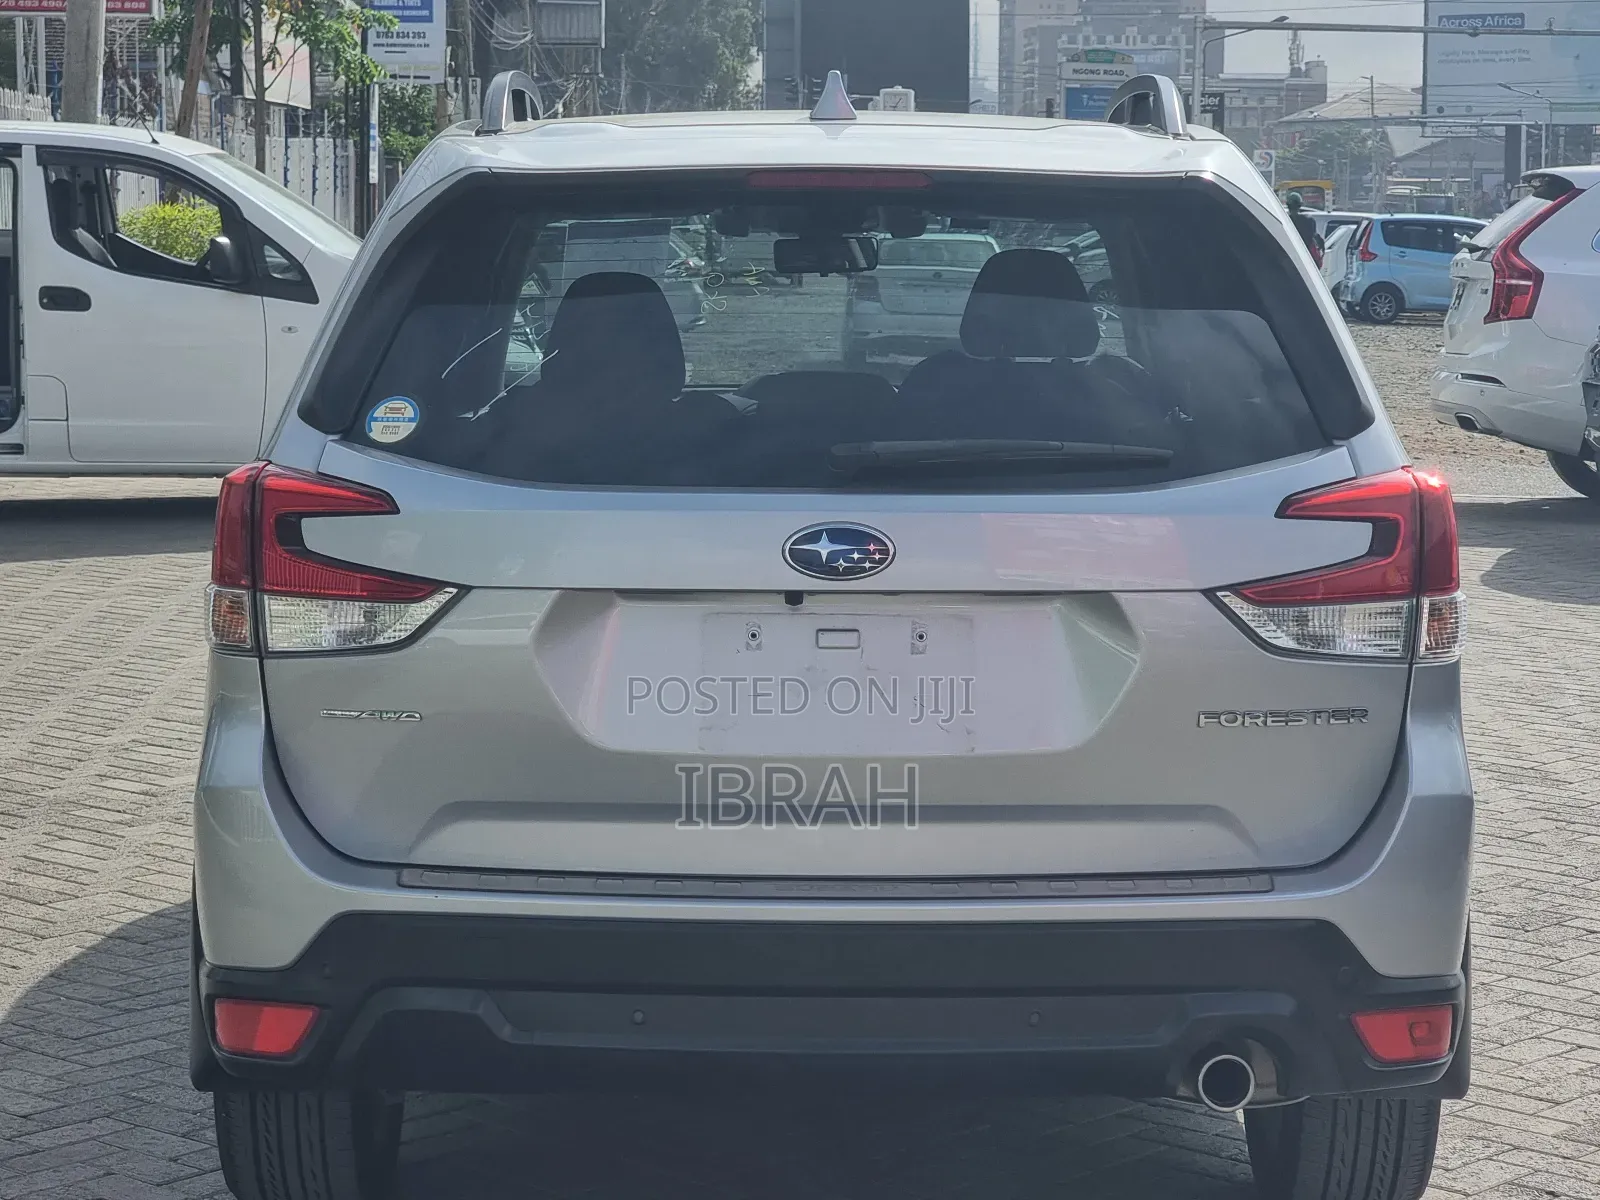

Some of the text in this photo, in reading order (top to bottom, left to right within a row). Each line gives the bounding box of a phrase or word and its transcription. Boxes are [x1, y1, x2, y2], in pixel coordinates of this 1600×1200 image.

[1439, 15, 1522, 28] Across Africa
[1072, 68, 1125, 77] NGONG ROAD
[1188, 95, 1220, 106] aier
[1197, 706, 1369, 729] FORESTER
